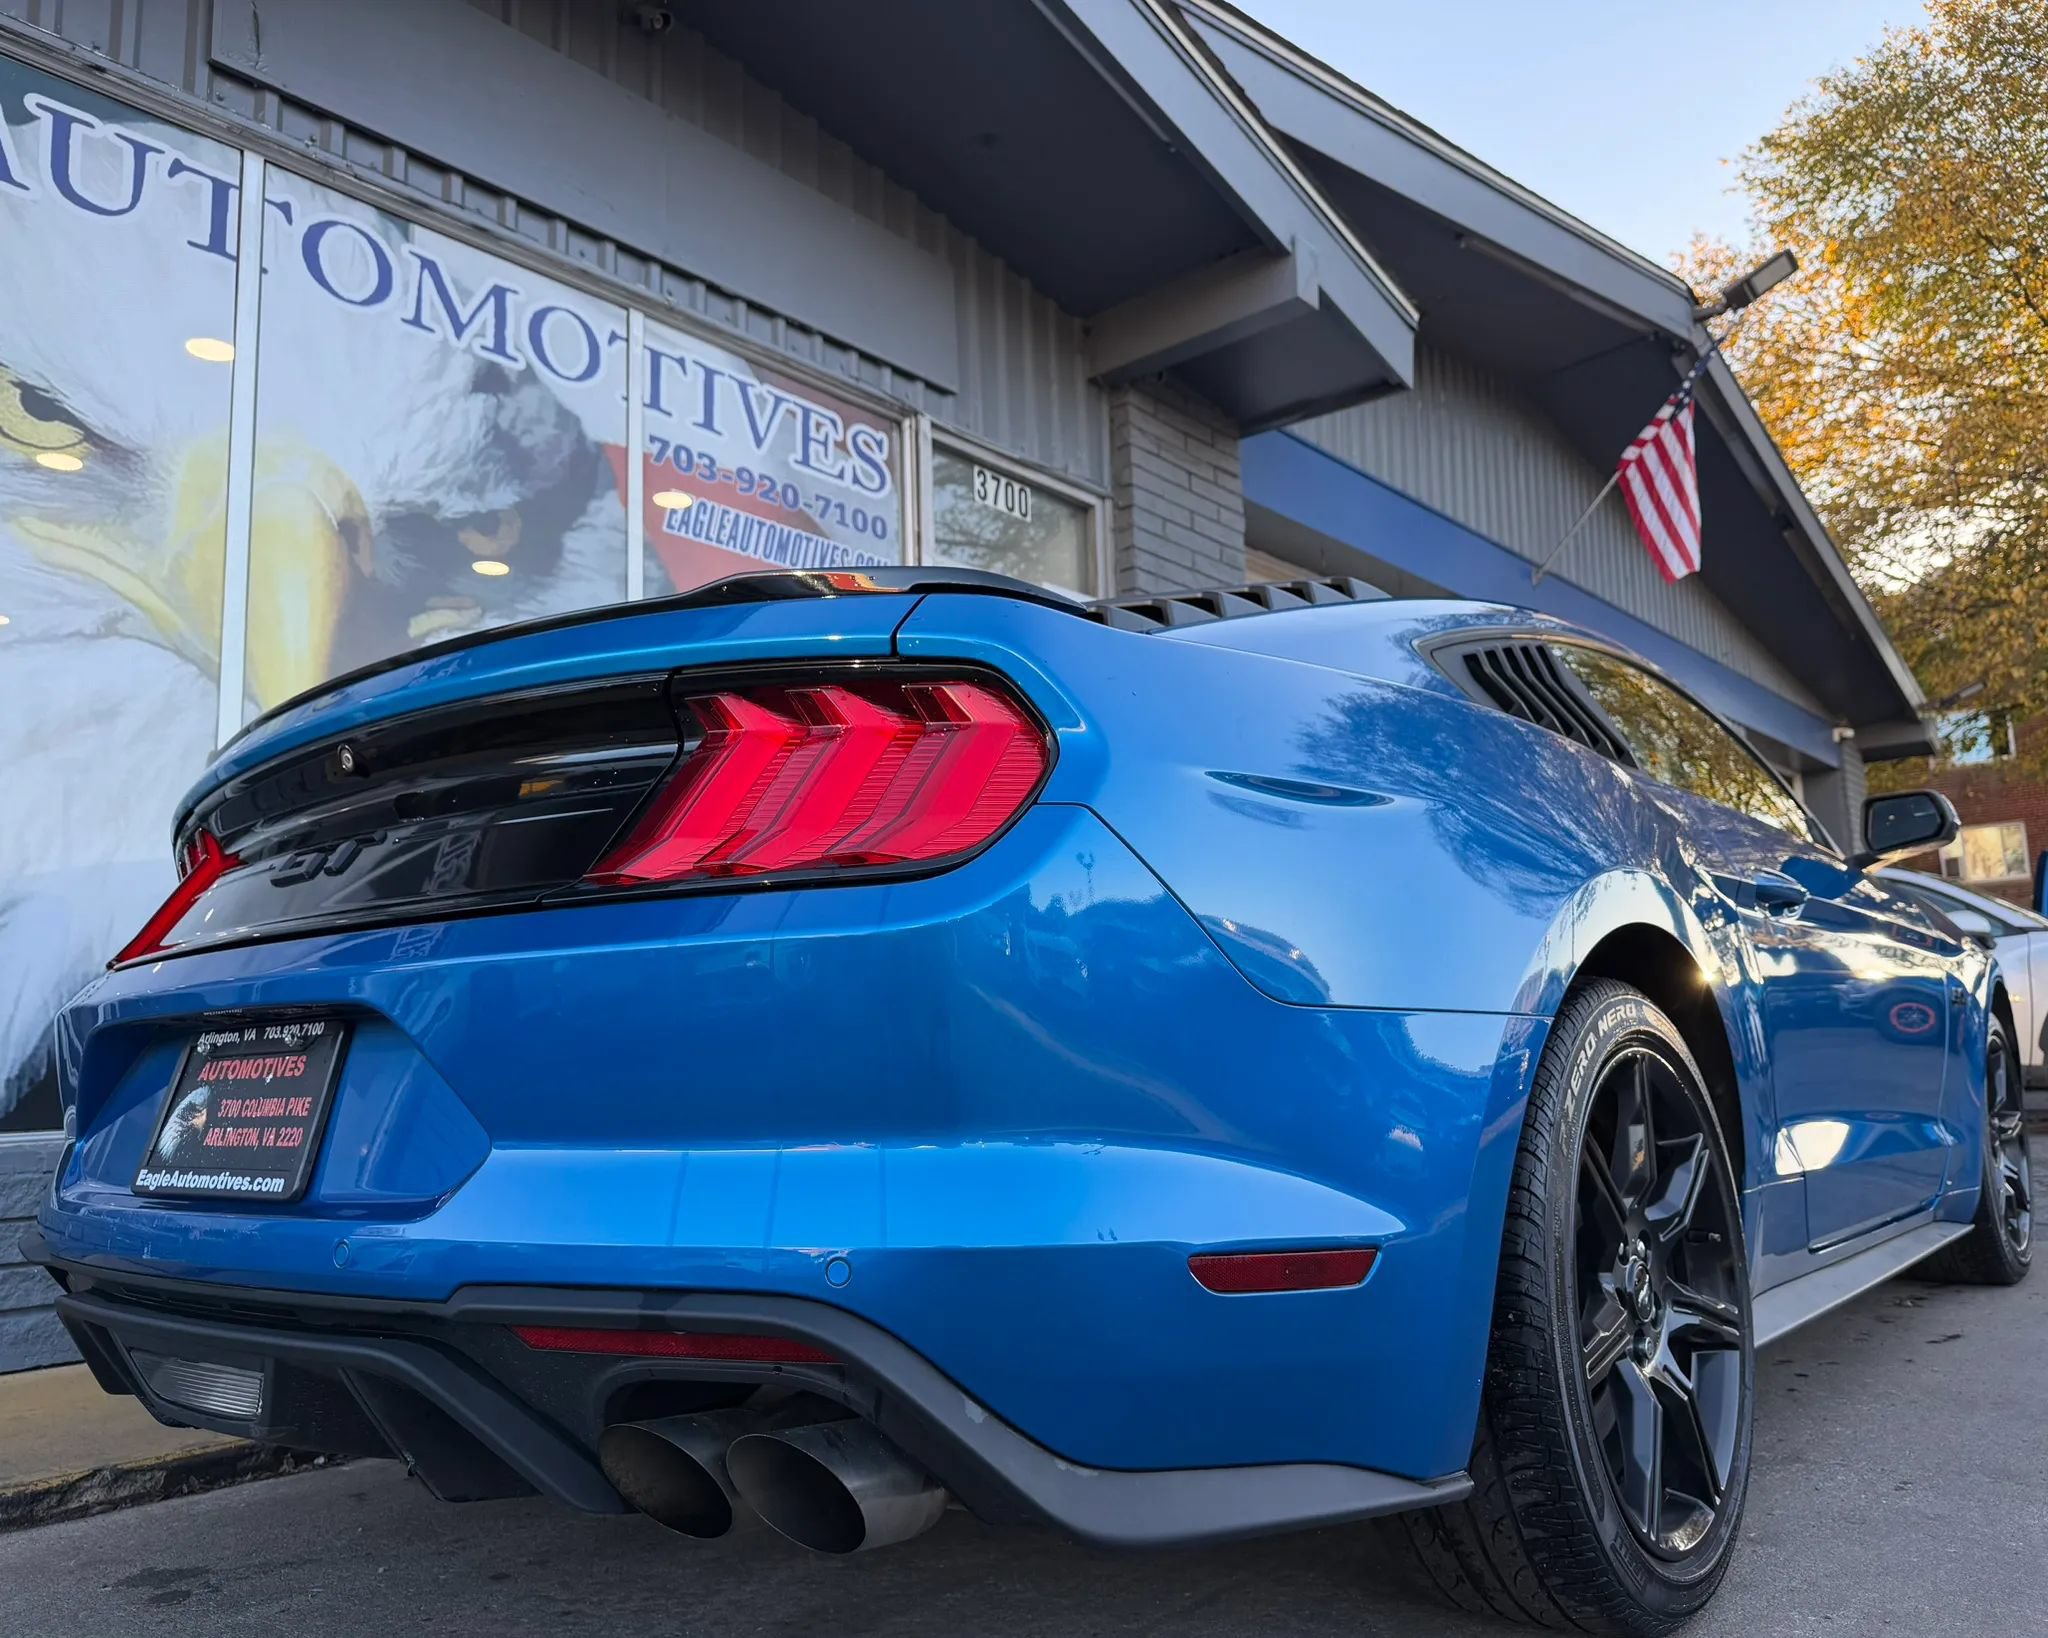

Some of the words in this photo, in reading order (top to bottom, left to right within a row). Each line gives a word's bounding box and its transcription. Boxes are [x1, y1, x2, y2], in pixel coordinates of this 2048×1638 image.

[0, 103, 891, 493] UTOMOTIVES
[648, 434, 888, 541] 703-920-7100
[975, 470, 1030, 519] 3700
[197, 1031, 241, 1046] Arlington,
[244, 1028, 257, 1041] VA
[263, 1022, 325, 1039] 703.920.7100
[197, 1055, 307, 1081] AUTOMOTIVES
[1564, 1031, 1597, 1122] ZERO
[1597, 1002, 1638, 1038] NERO
[217, 1099, 242, 1117] 3700
[241, 1097, 286, 1118] COLUMBIA
[286, 1096, 312, 1117] PIKE
[203, 1127, 260, 1151] ARLINGTON,
[262, 1127, 276, 1147] VA
[276, 1126, 304, 1147] 2220
[136, 1168, 285, 1193] EagleAutomotives.com
